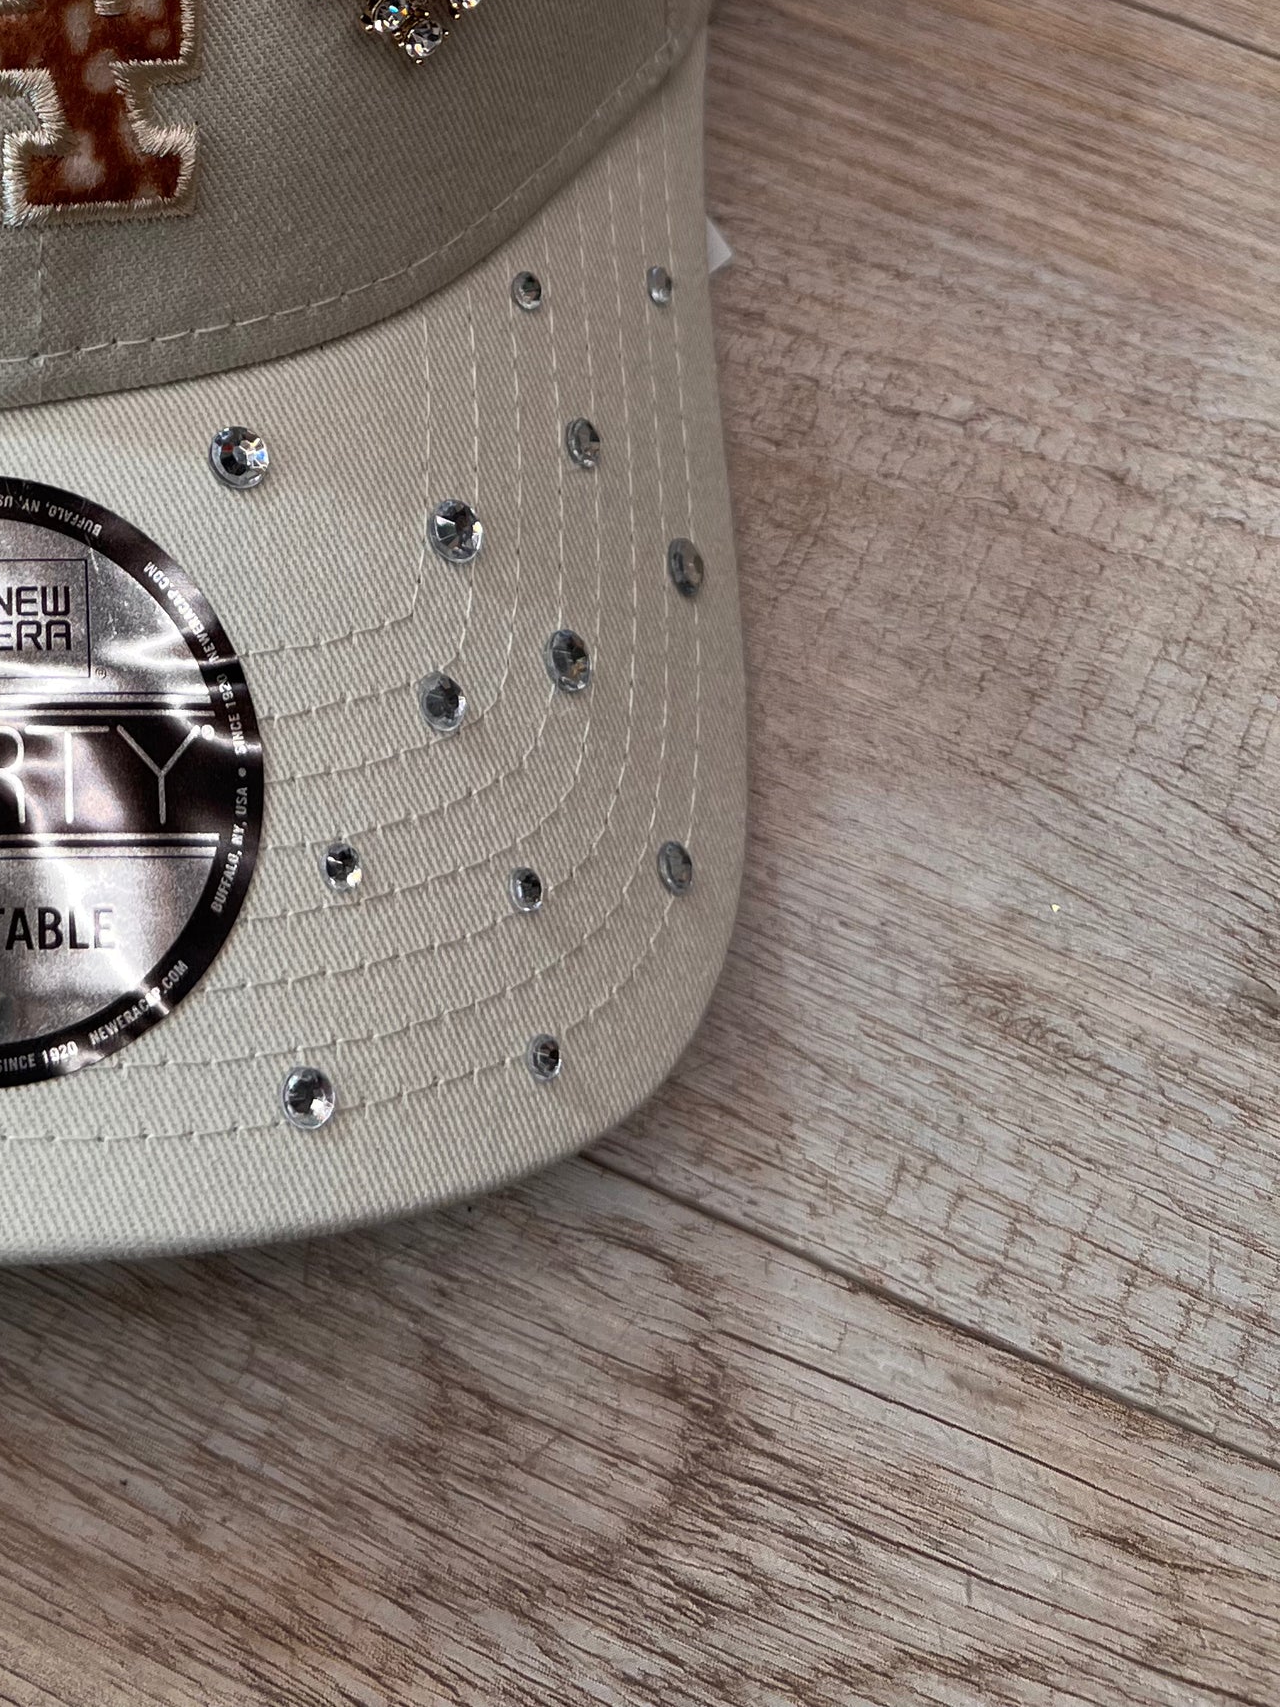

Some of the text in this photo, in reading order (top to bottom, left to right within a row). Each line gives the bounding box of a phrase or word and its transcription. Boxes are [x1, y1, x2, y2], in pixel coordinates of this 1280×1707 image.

[143, 561, 220, 664] NEWERACAP.COM
[217, 672, 237, 708] 1920
[228, 713, 247, 755] SINCE
[234, 786, 248, 816] USA
[41, 1040, 79, 1066] 1920
[88, 960, 188, 1047] NEWERACAP.COM
